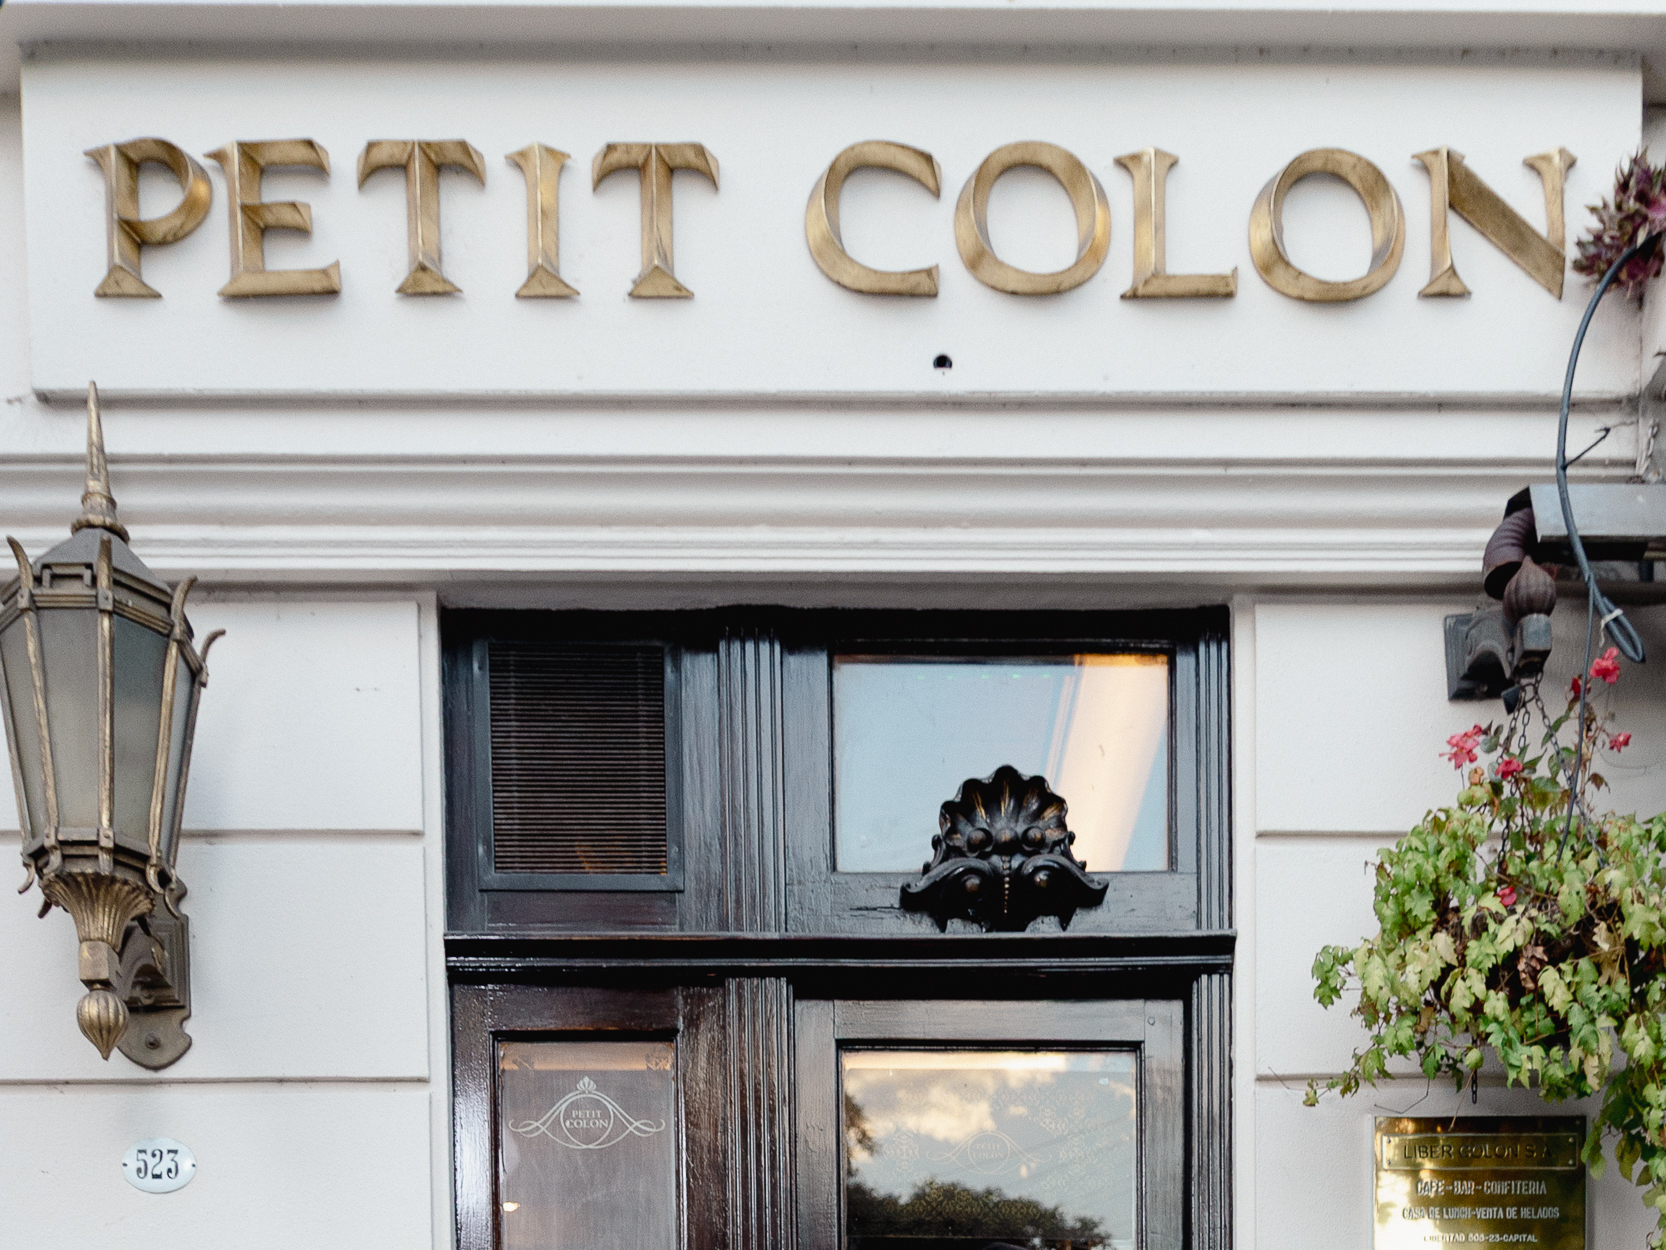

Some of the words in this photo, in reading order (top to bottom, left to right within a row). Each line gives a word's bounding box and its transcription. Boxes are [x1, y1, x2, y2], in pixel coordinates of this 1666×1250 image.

[83, 137, 720, 299] PETIT
[805, 140, 1577, 304] COLON
[571, 1109, 602, 1118] PETIT
[566, 1118, 608, 1128] COLON
[1403, 1144, 1453, 1160] LIBER
[1458, 1143, 1519, 1160] COLON
[136, 1148, 178, 1179] 523
[1402, 1207, 1425, 1220] CASA
[1427, 1207, 1440, 1219] DE
[1506, 1206, 1518, 1219] DE
[1520, 1206, 1560, 1219] HELADOS
